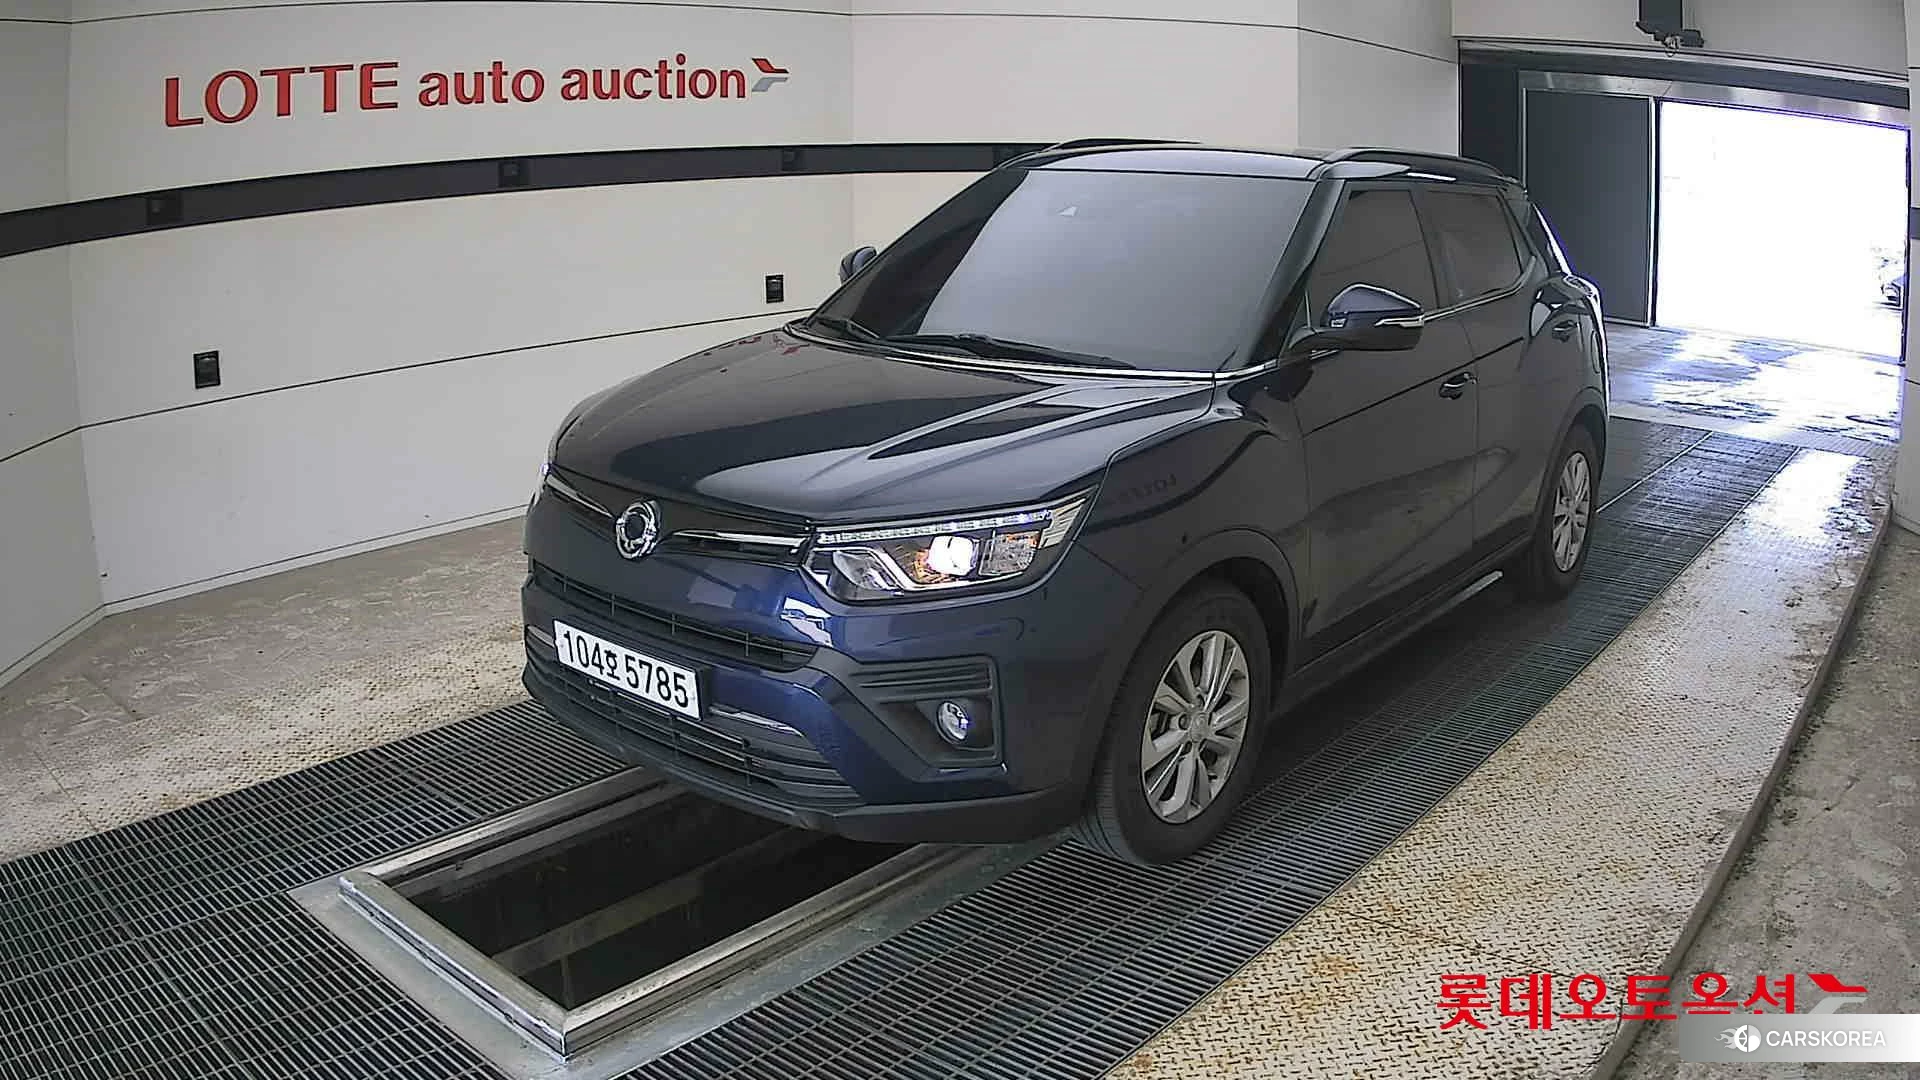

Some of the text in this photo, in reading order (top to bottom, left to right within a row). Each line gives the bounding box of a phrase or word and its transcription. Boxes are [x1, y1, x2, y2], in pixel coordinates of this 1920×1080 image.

[164, 53, 747, 128] LOTTE auto auction
[624, 653, 690, 709] 5785
